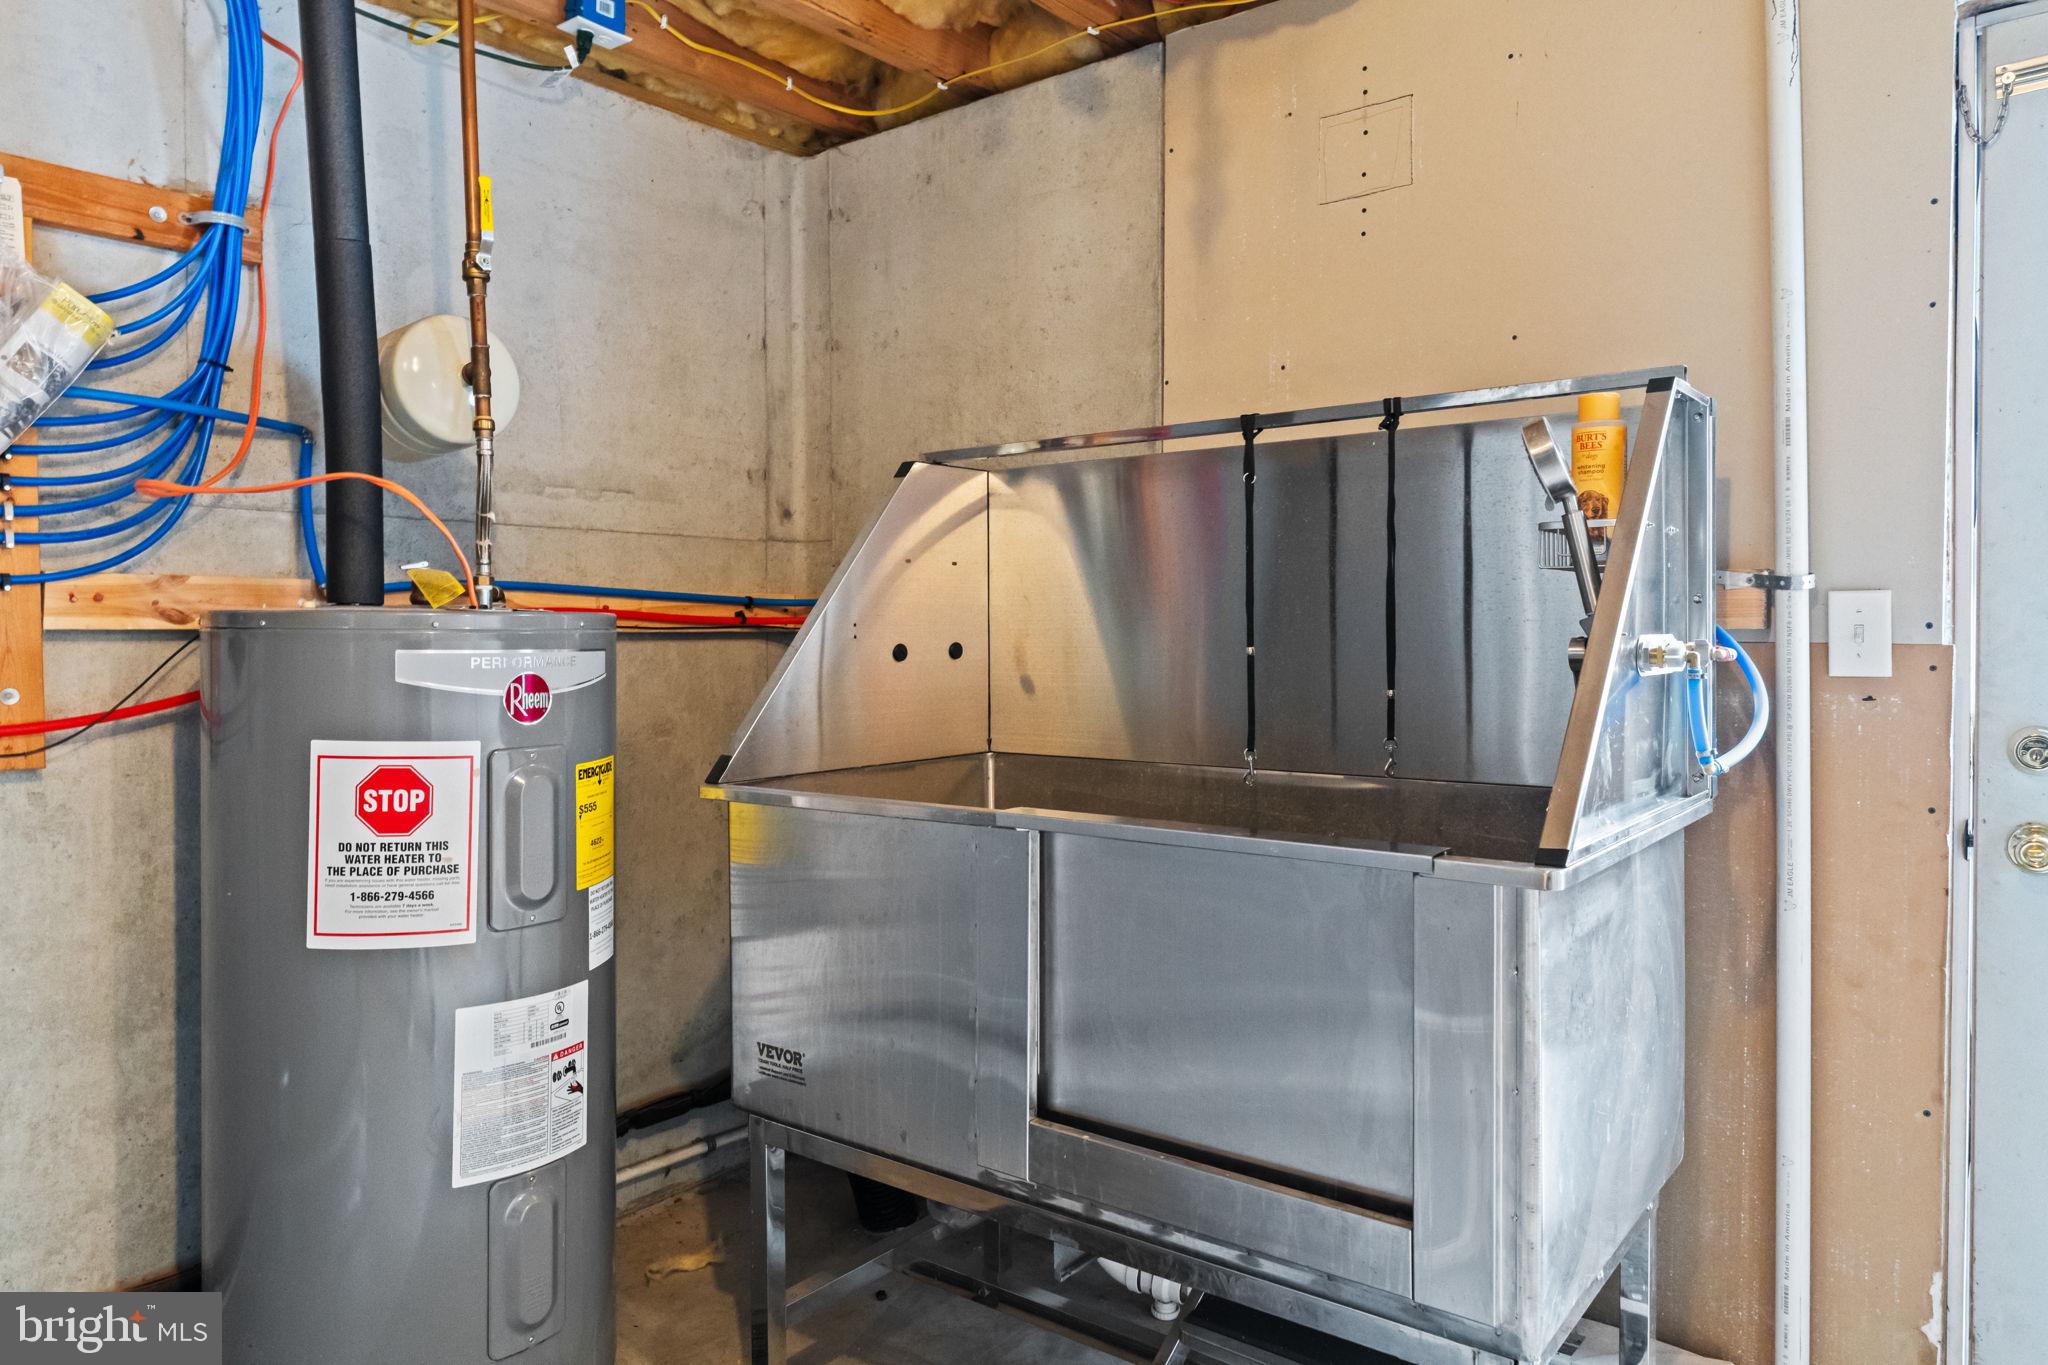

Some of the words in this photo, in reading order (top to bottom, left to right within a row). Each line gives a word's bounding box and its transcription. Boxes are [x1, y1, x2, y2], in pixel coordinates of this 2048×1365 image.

[1785, 375, 1791, 383] in
[1577, 433, 1607, 442] BURT'S
[1580, 441, 1603, 450] BEES
[470, 656, 576, 669] PERFORMANCE
[510, 675, 549, 717] Rheem
[363, 789, 425, 813] STOP
[579, 801, 597, 814] $555
[338, 842, 353, 852] DO
[355, 842, 376, 852] NOT
[380, 842, 421, 852] RETURN
[426, 841, 449, 851] THIS
[344, 854, 381, 865] WATER
[385, 853, 425, 864] HEATER
[428, 853, 442, 863] TO
[327, 866, 346, 877] THE
[349, 866, 383, 877] PLACE
[387, 866, 400, 876] OF
[403, 864, 460, 876] PURCHASE
[1786, 862, 1794, 886] EAGLE
[350, 890, 435, 902] 1-866-279-4566
[1786, 889, 1793, 898] JM
[559, 1043, 583, 1057] DANGER
[757, 1042, 802, 1067] VEVOR
[1784, 1244, 1790, 1252] in
